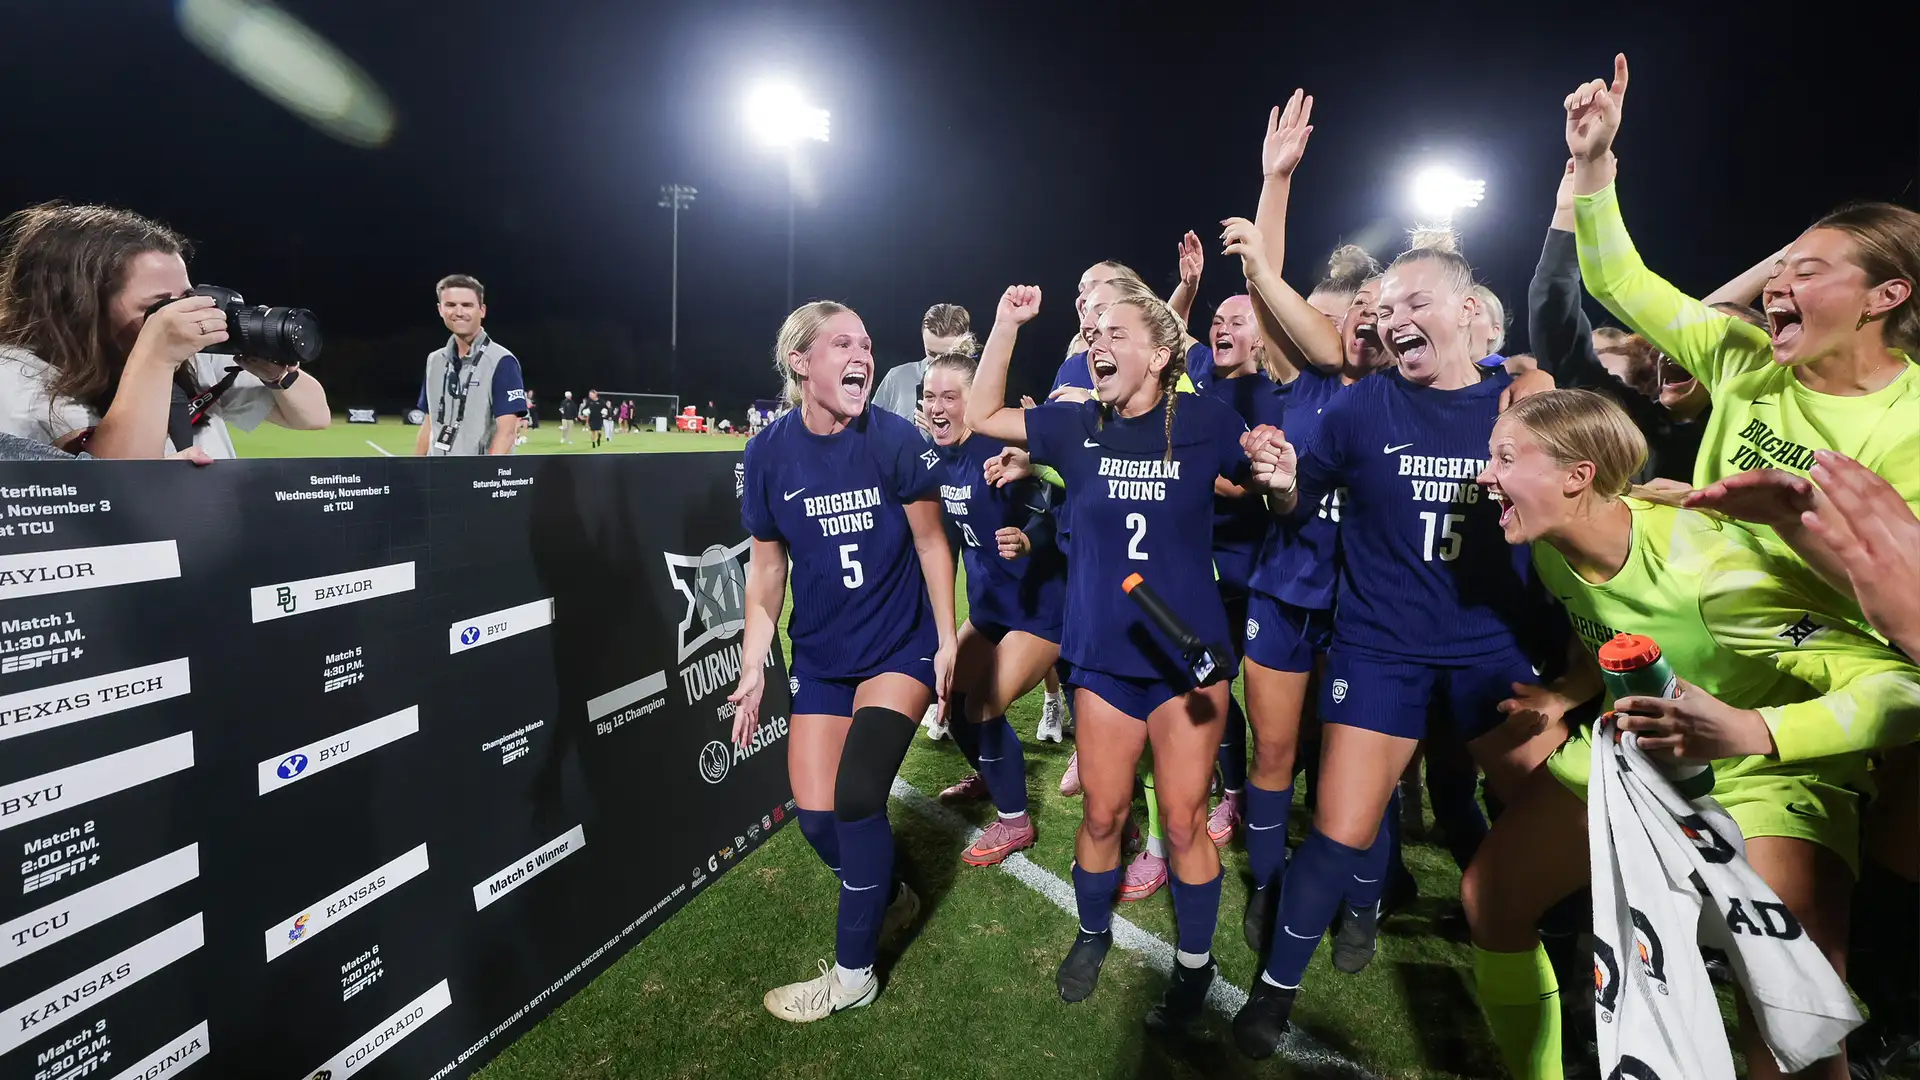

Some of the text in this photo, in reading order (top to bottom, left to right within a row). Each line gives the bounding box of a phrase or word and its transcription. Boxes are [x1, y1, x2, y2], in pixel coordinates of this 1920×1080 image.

[310, 474, 361, 485] Semifinals
[498, 468, 512, 476] Final
[1098, 456, 1180, 480] BRIGHAM
[0, 484, 77, 498] terfinals
[275, 486, 390, 501] Wednesday, November 5
[473, 480, 501, 489] Saturday,
[501, 478, 528, 487] November
[492, 489, 517, 499] at Baylor
[1107, 479, 1166, 501] YOUNG
[1411, 479, 1479, 505] YOUNG
[8, 501, 96, 517] November
[99, 500, 111, 511] 3
[323, 501, 354, 512] at TCU
[803, 487, 881, 518] BRIGHAM
[18, 521, 54, 536] TCU
[818, 511, 874, 537] YOUNG
[1125, 512, 1149, 561] 2
[1419, 511, 1466, 562] 15
[839, 543, 864, 589] 5
[315, 579, 373, 600] BAYLOR
[2, 612, 75, 634] Match 1
[487, 622, 508, 635] BYU
[49, 628, 86, 646] A.M.
[2, 646, 84, 675] ESPN+
[323, 660, 364, 678] 4:30 P.M.
[325, 647, 362, 665] Match 5
[0, 676, 164, 727] TEXAS TECH
[596, 697, 666, 736] Big 12 Champion
[482, 719, 544, 752] Championship Match
[501, 742, 515, 754] 7:00
[319, 740, 351, 762] BYU
[1, 784, 63, 816] BYU
[24, 820, 95, 856] Match 2
[21, 837, 100, 875] 2:00 P.M.
[489, 841, 569, 896] Match 6 Winner
[708, 854, 718, 872] G
[23, 853, 101, 895] ESPN+
[326, 876, 386, 918] KANSAS
[12, 910, 70, 947] TCU
[341, 944, 380, 974] Match 6
[341, 956, 383, 987] 7:00 P.M.
[457, 1035, 490, 1064] SOCCER
[489, 1009, 524, 1039] STADIUM
[529, 988, 551, 1008] BETTY
[550, 978, 564, 993] LOU
[563, 964, 582, 982] MAYS
[581, 948, 604, 969] SOCCER
[603, 935, 620, 951] FIELD
[622, 923, 636, 937] FORT
[635, 909, 654, 926] WORTH
[671, 883, 686, 898] TEXAS
[20, 962, 131, 1031] KANSAS
[37, 1018, 106, 1067] Match 3
[79, 1034, 112, 1062] P.M.
[345, 1006, 424, 1069] COLORADO
